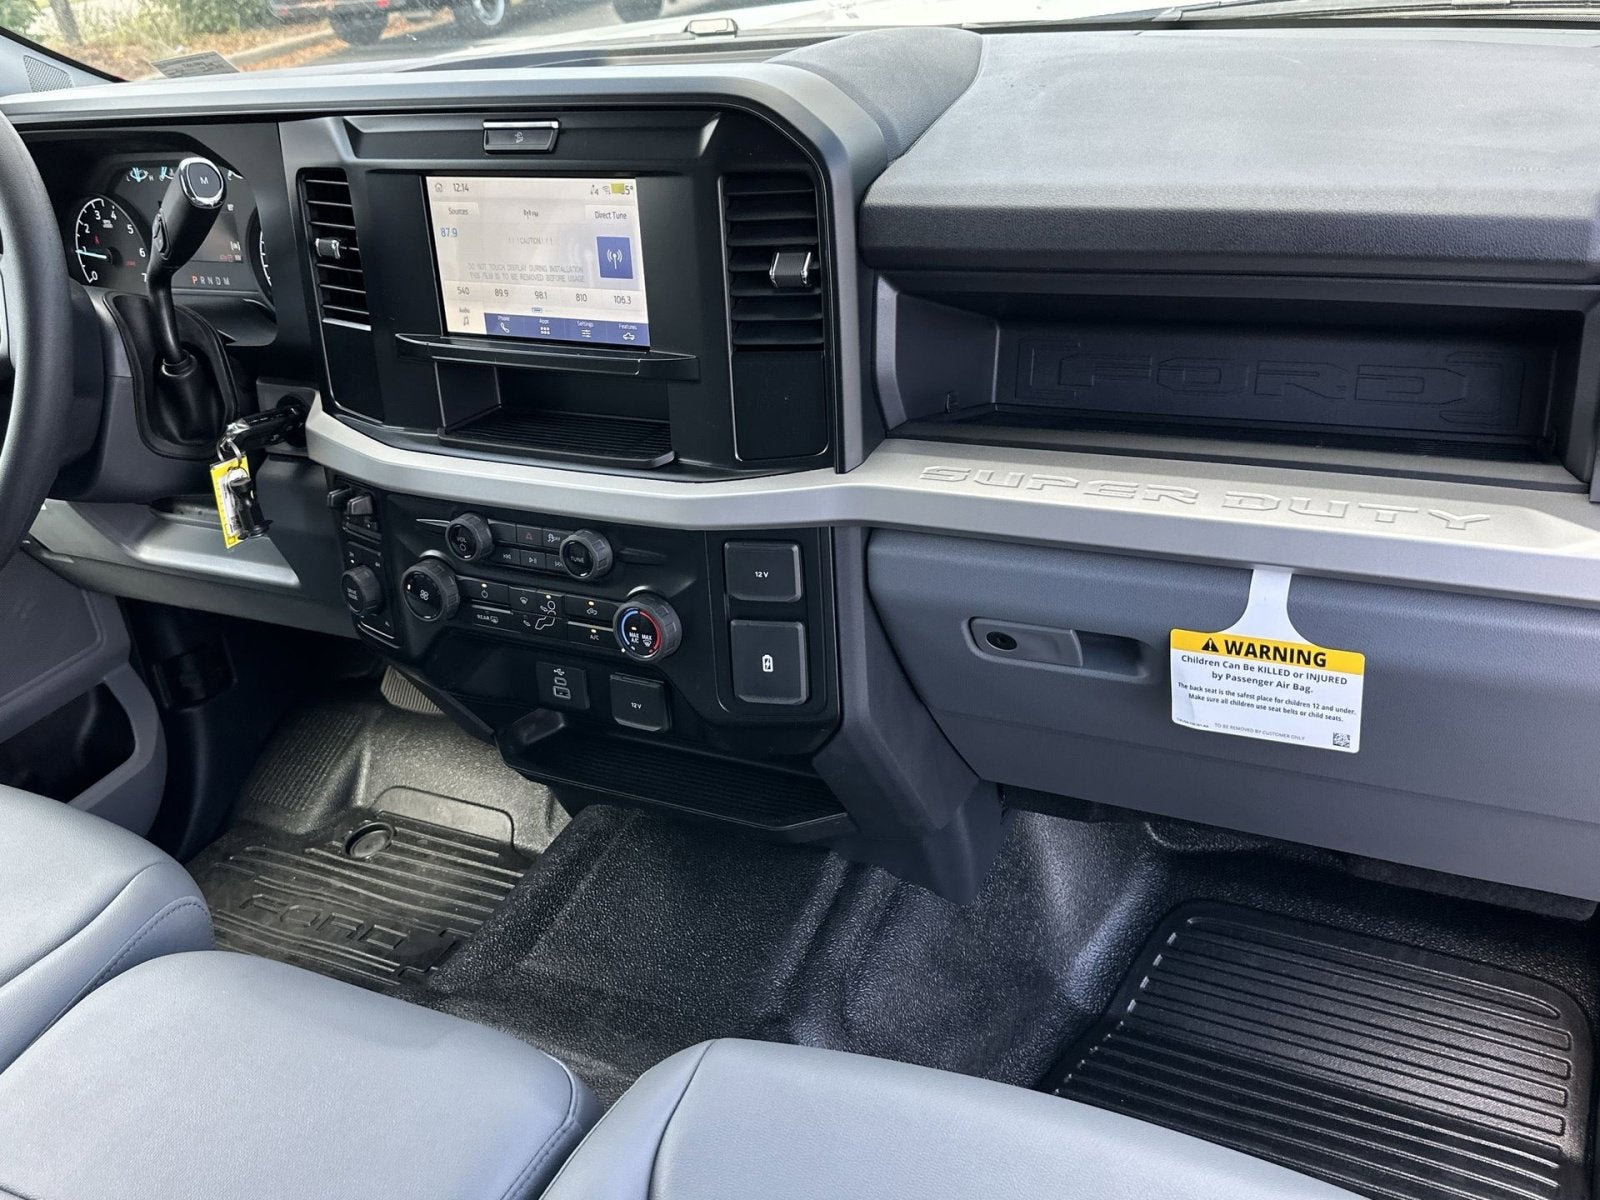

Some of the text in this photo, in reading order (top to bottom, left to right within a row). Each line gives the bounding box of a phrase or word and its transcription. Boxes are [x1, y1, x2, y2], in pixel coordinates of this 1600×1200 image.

[200, 176, 209, 184] M
[94, 210, 101, 220] 3
[111, 211, 117, 220] 4
[595, 211, 611, 219] Direct
[84, 224, 90, 233] 2
[127, 224, 134, 234] 5
[441, 228, 458, 237] 87.9
[139, 248, 146, 258] 6
[91, 270, 98, 280] 0
[141, 273, 147, 282] 7
[192, 276, 198, 284] P
[200, 276, 205, 284] R
[207, 276, 213, 285] N
[215, 276, 221, 285] D
[457, 287, 470, 295] 540
[495, 289, 509, 297] 89.9
[535, 291, 547, 299] 98.1
[576, 293, 587, 302] 810
[614, 296, 631, 304] 106.3
[1059, 353, 1466, 405] FORD
[919, 465, 1490, 531] SUPER DUTY
[571, 555, 584, 564] TUNE
[1225, 640, 1326, 667] WARNING
[1182, 655, 1220, 667] Children
[1223, 661, 1240, 670] Can
[1243, 664, 1255, 672] Be
[1258, 666, 1290, 677] KILLED
[1306, 672, 1347, 684] INJURED
[1212, 671, 1313, 694] by Passenger Air Bag.
[1188, 693, 1205, 701] Make
[1230, 699, 1254, 708] children
[1283, 707, 1298, 715] belts
[1308, 710, 1324, 718] child
[1325, 714, 1344, 722] seats.
[1237, 691, 1255, 699] safest
[1285, 698, 1310, 708] children
[1335, 706, 1356, 715] under.
[1230, 725, 1254, 733] REMOVED
[1262, 730, 1290, 739] CUSTOMER
[239, 894, 408, 950] FORD
